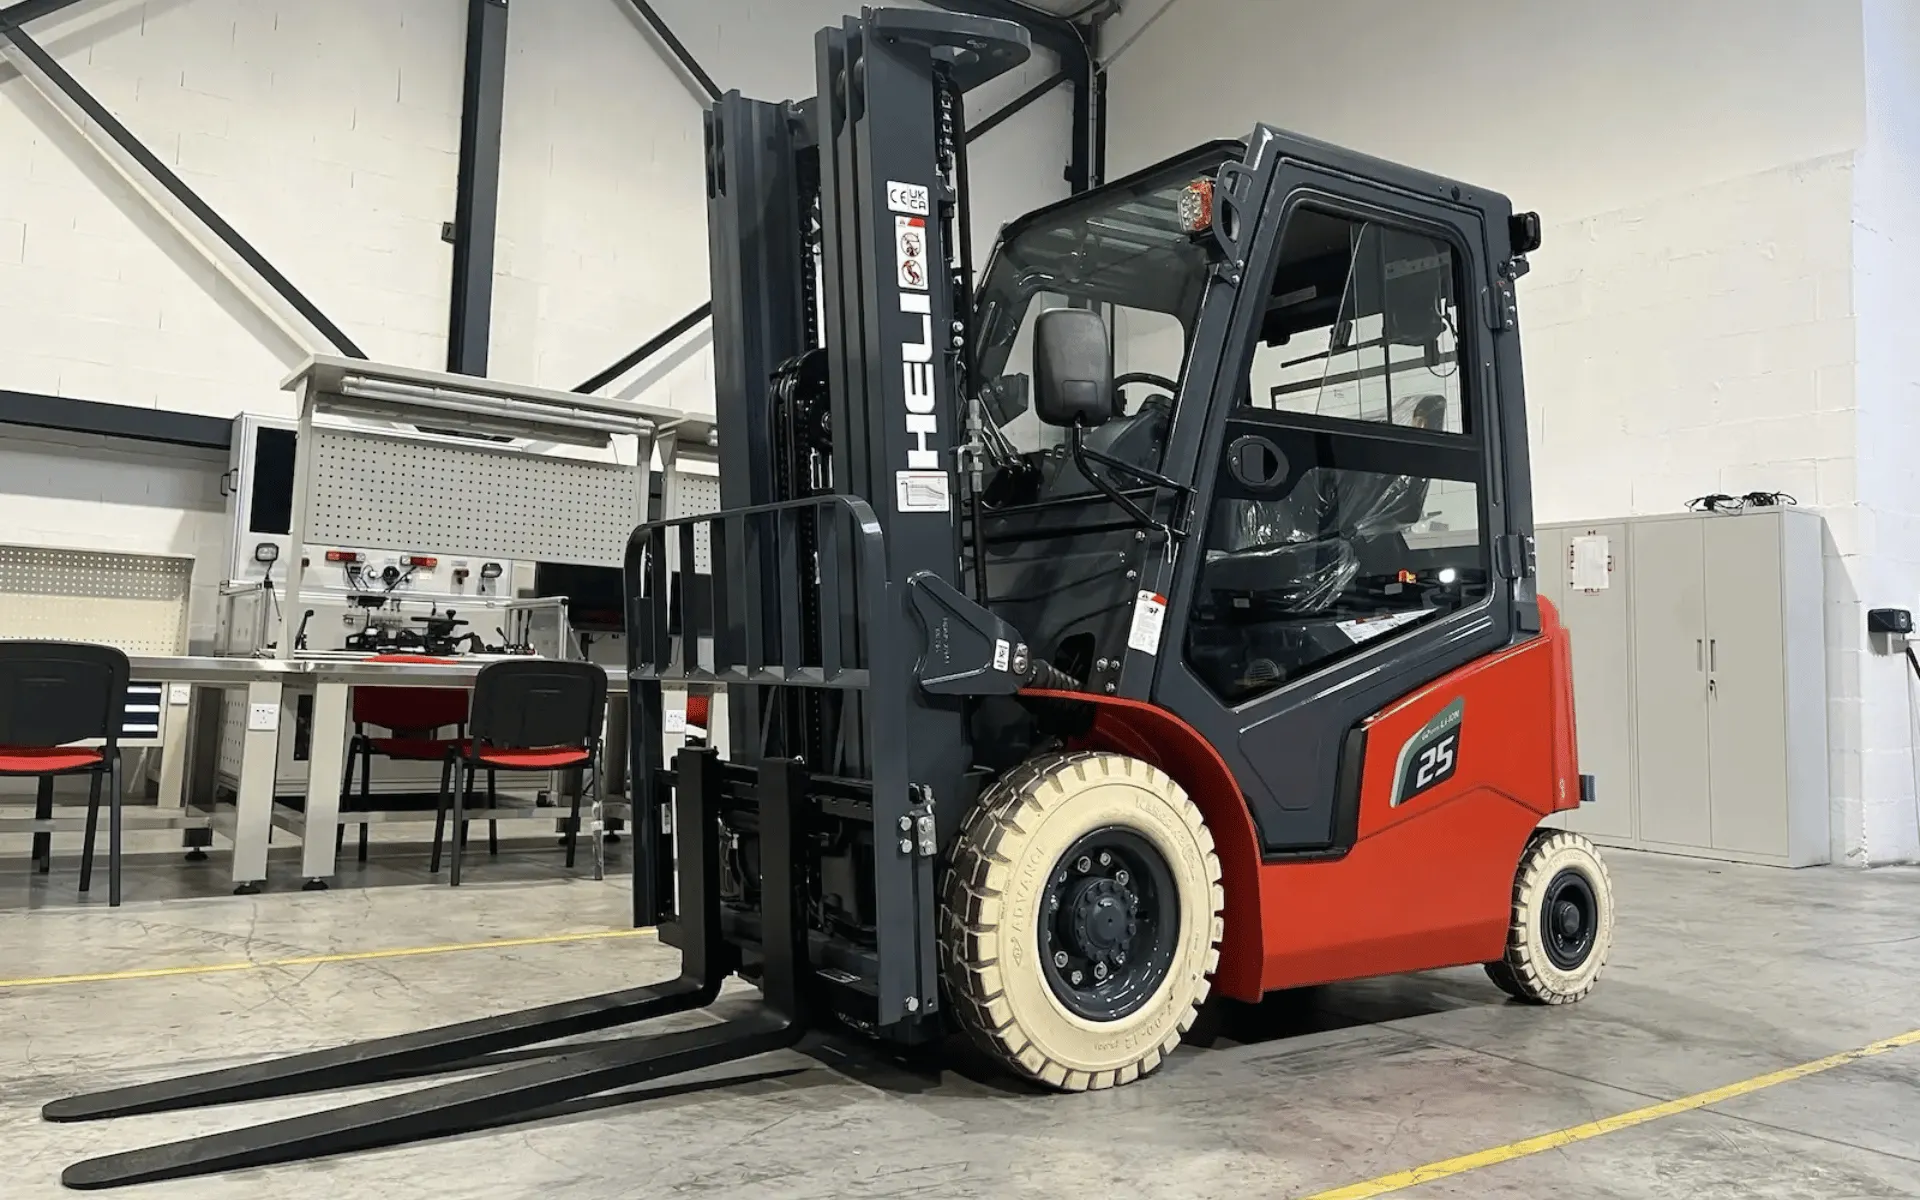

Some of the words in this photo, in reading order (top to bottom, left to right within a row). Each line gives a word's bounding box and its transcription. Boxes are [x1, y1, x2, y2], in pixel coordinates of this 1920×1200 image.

[909, 188, 925, 200] UK
[910, 200, 927, 210] CA
[899, 292, 940, 470] HELI
[1416, 735, 1455, 789] 25
